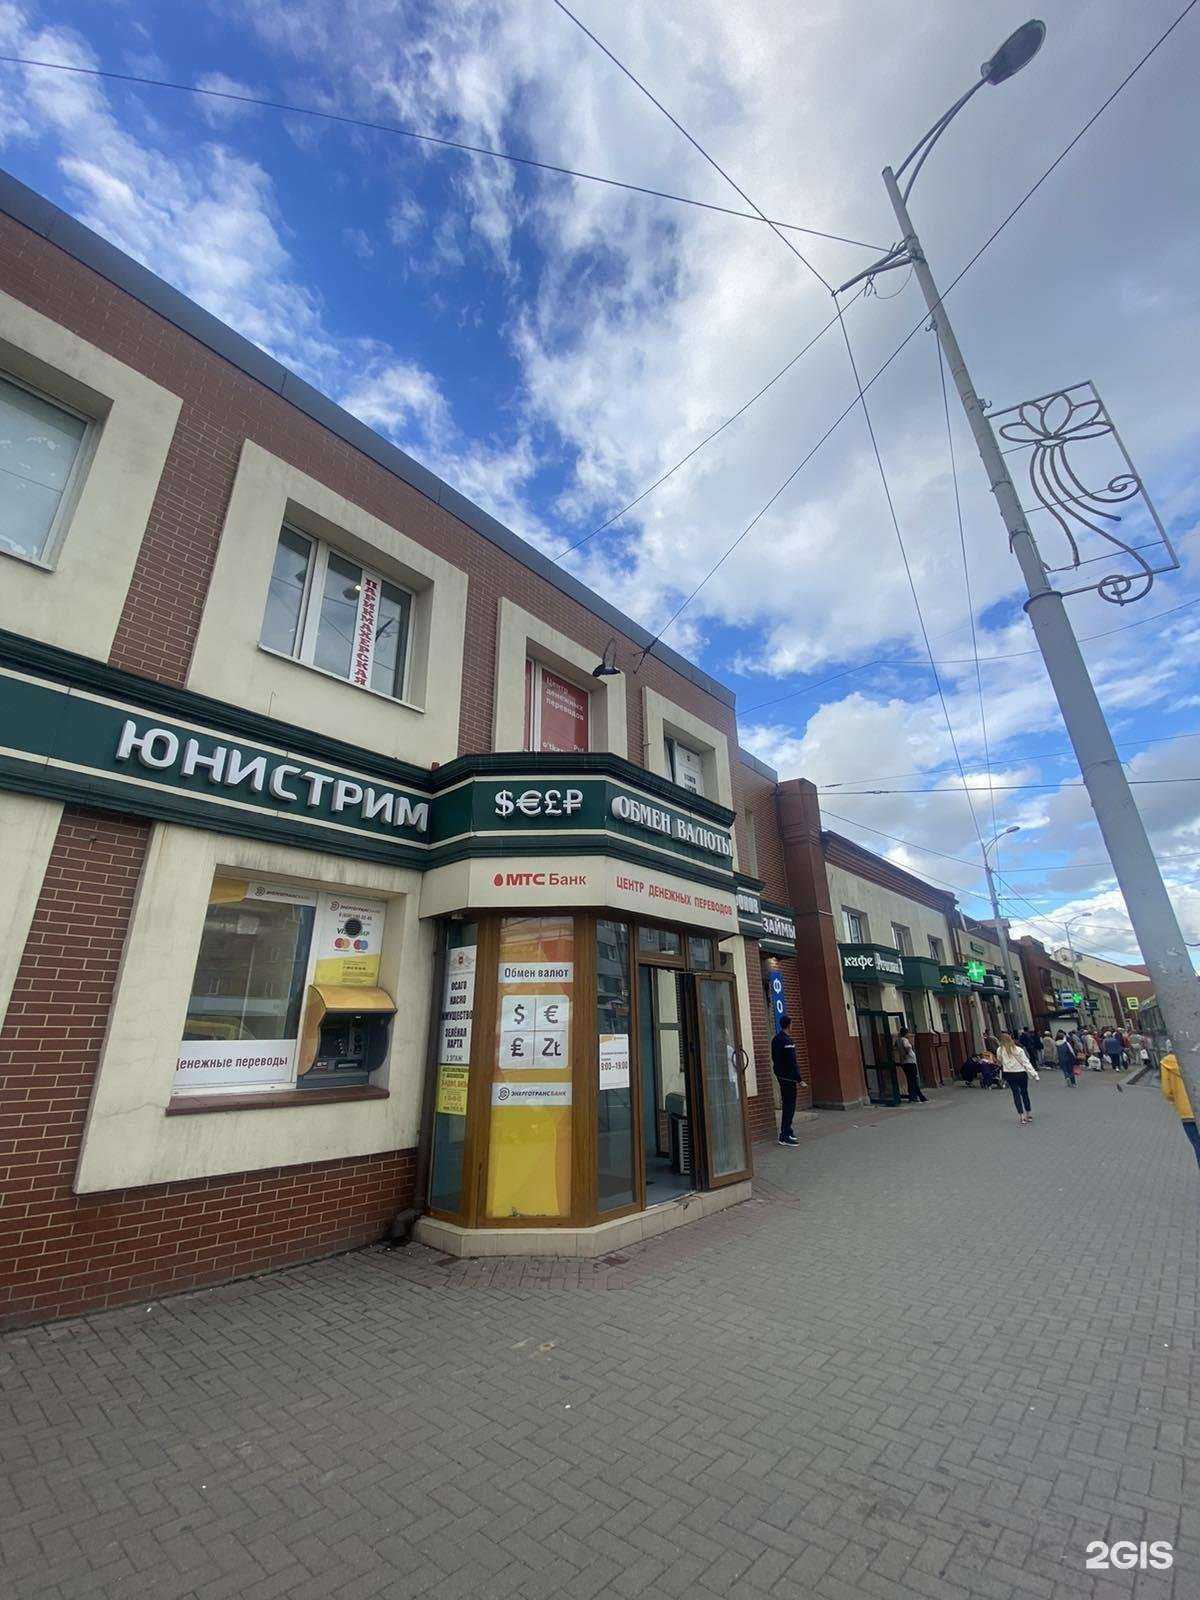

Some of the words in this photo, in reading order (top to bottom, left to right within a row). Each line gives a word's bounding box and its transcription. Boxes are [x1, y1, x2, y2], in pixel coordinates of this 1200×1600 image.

[115, 719, 428, 832] ЮНИСТРИМ
[611, 795, 671, 836] ОБМЕН
[674, 817, 733, 858] ВАЛЮТЫ
[506, 874, 546, 886] МТС
[549, 873, 587, 886] Банк
[616, 876, 644, 893] ЦЕНТР
[648, 884, 692, 906] ДЕНЕЖНЫХ
[694, 897, 732, 916] ПЕРЕВОДОВ
[763, 918, 796, 939] ЗАЙМЫ
[504, 967, 536, 978] Обмен
[537, 967, 569, 978] валют
[844, 955, 874, 970] кафе
[514, 1004, 525, 1025] $
[543, 1004, 559, 1024] €
[510, 1037, 525, 1057] £
[235, 1056, 288, 1070] переводы
